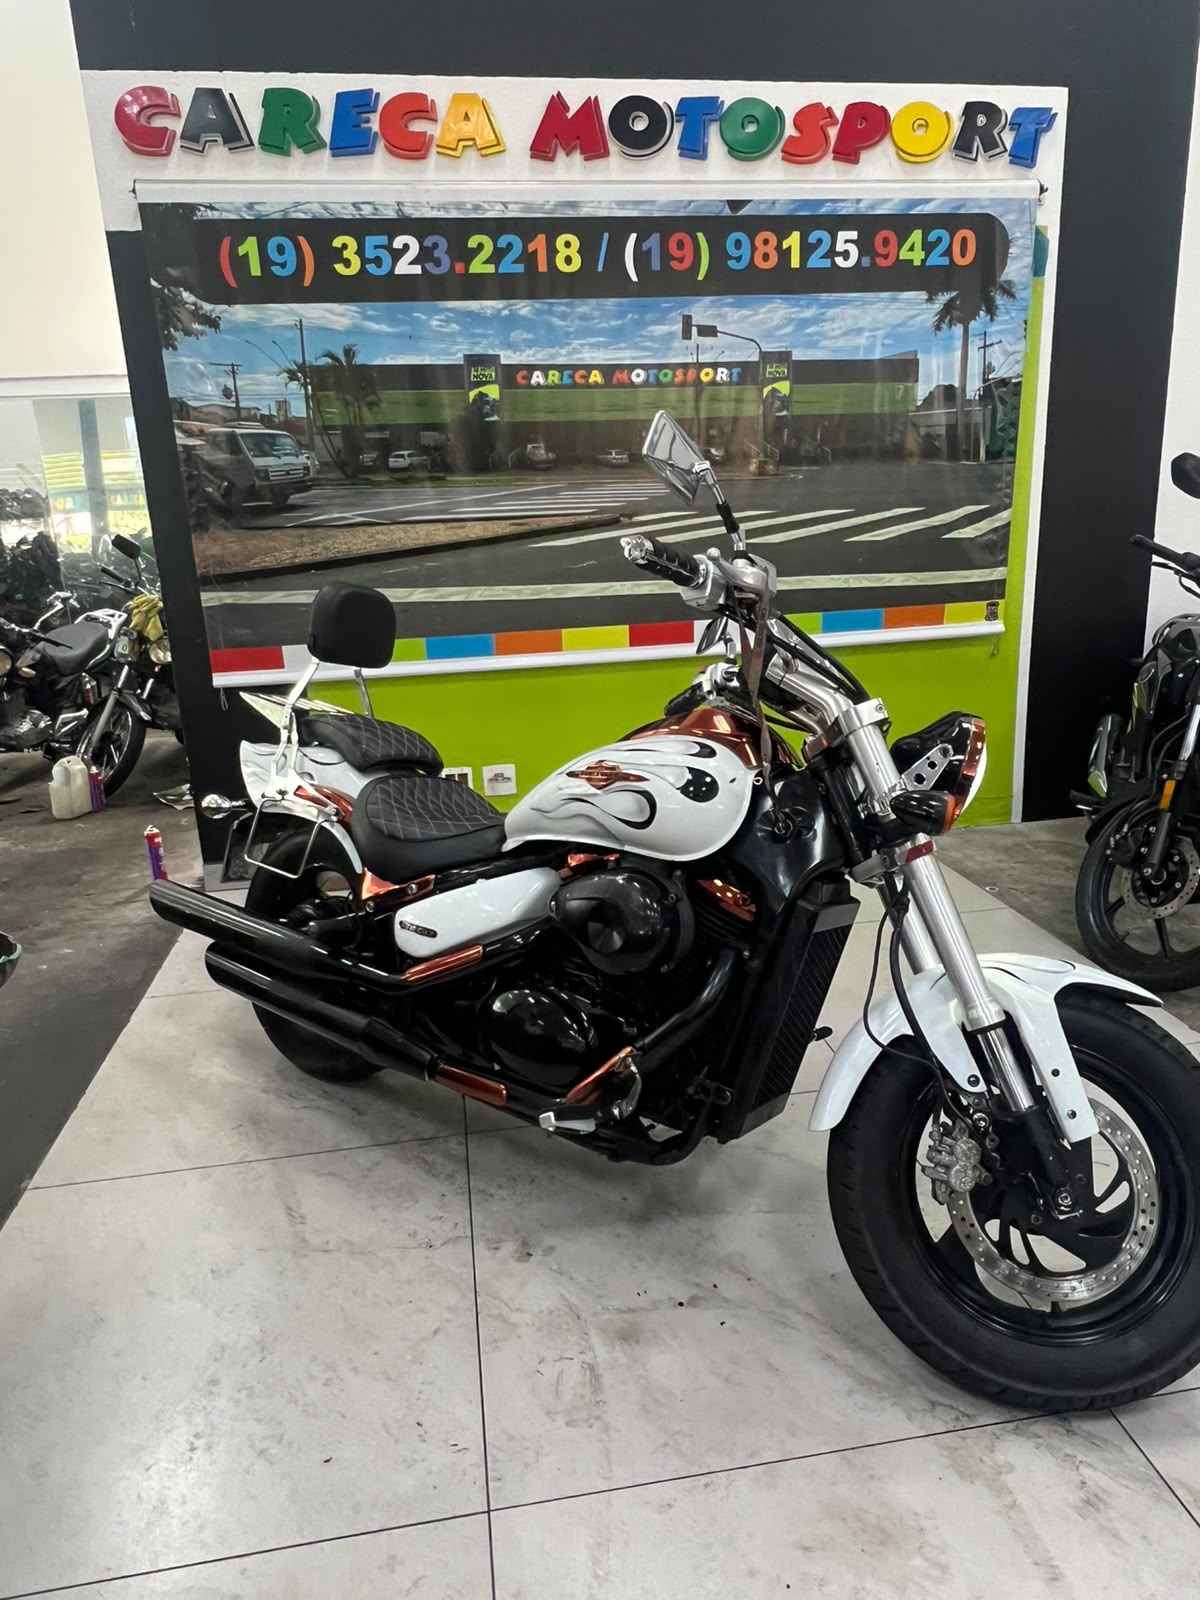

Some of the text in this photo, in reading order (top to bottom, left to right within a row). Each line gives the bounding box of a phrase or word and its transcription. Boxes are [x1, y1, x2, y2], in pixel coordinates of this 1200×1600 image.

[114, 85, 1058, 169] CARECA MOTOSPORT
[219, 235, 316, 288] (19)
[331, 233, 583, 277] 3523.2218
[624, 232, 710, 283] (19)
[726, 229, 977, 271] 98125.9420
[515, 367, 742, 387] CARECA MOTOSPORT
